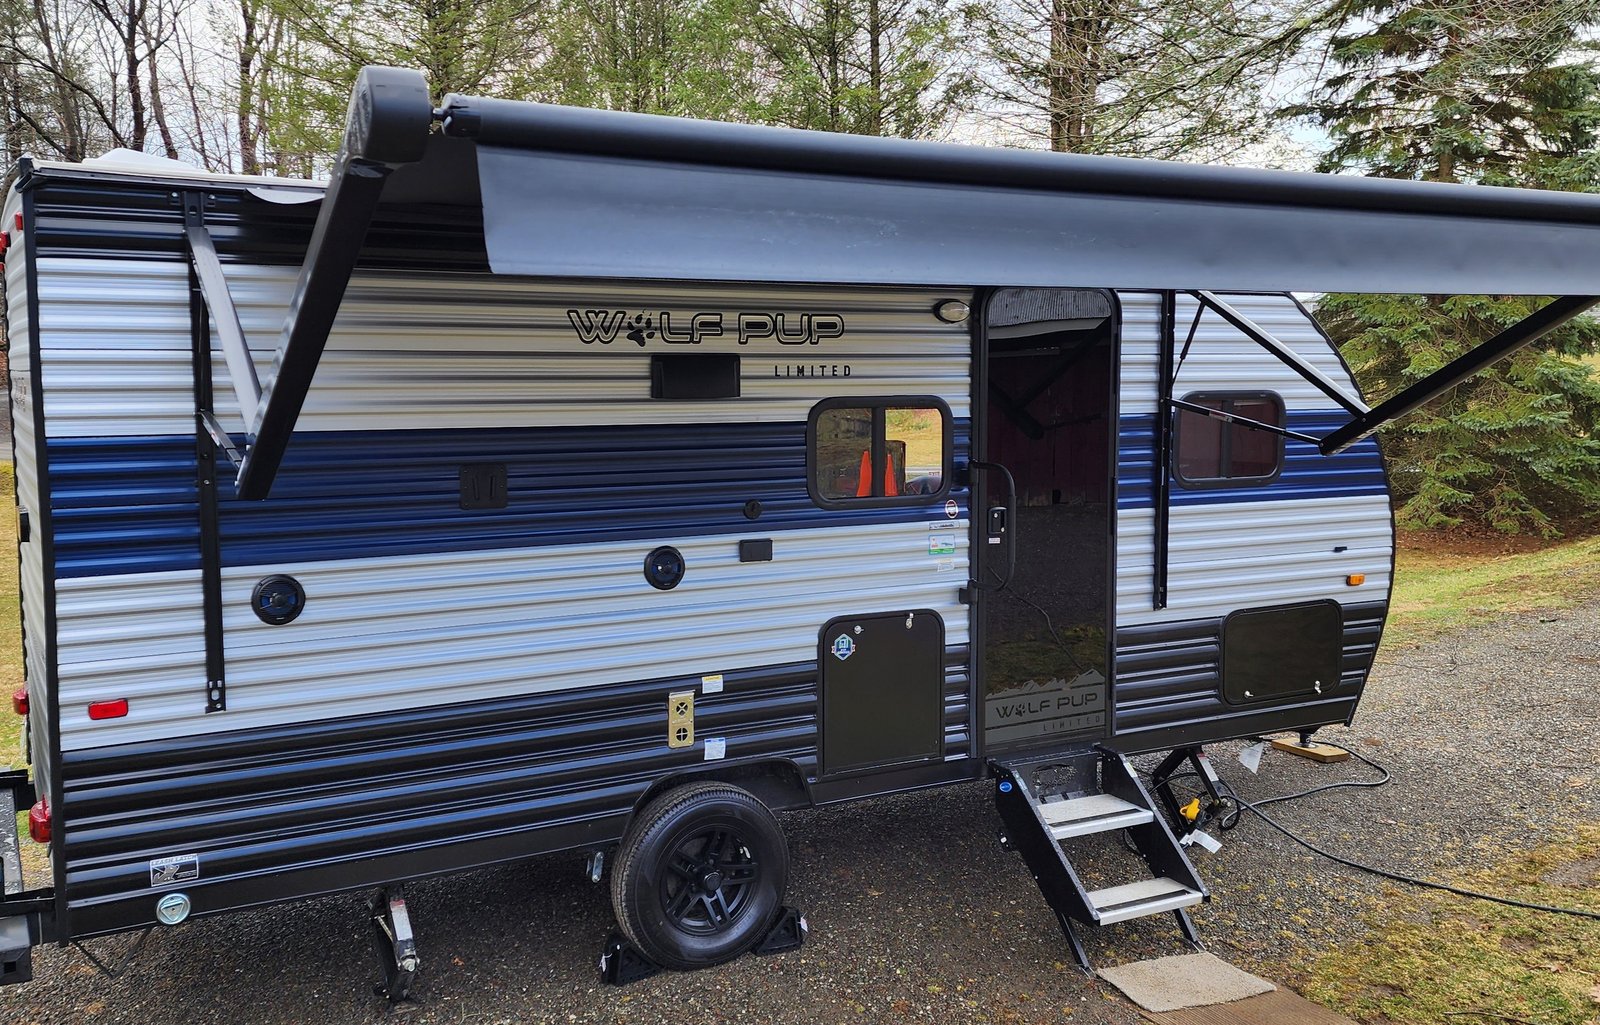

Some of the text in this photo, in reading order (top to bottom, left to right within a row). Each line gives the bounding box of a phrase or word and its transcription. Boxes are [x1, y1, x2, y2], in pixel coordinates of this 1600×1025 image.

[738, 313, 845, 345] PUP
[774, 365, 851, 377] LIMITED
[1057, 693, 1097, 709] PUP
[1043, 716, 1099, 731] LIMITED
